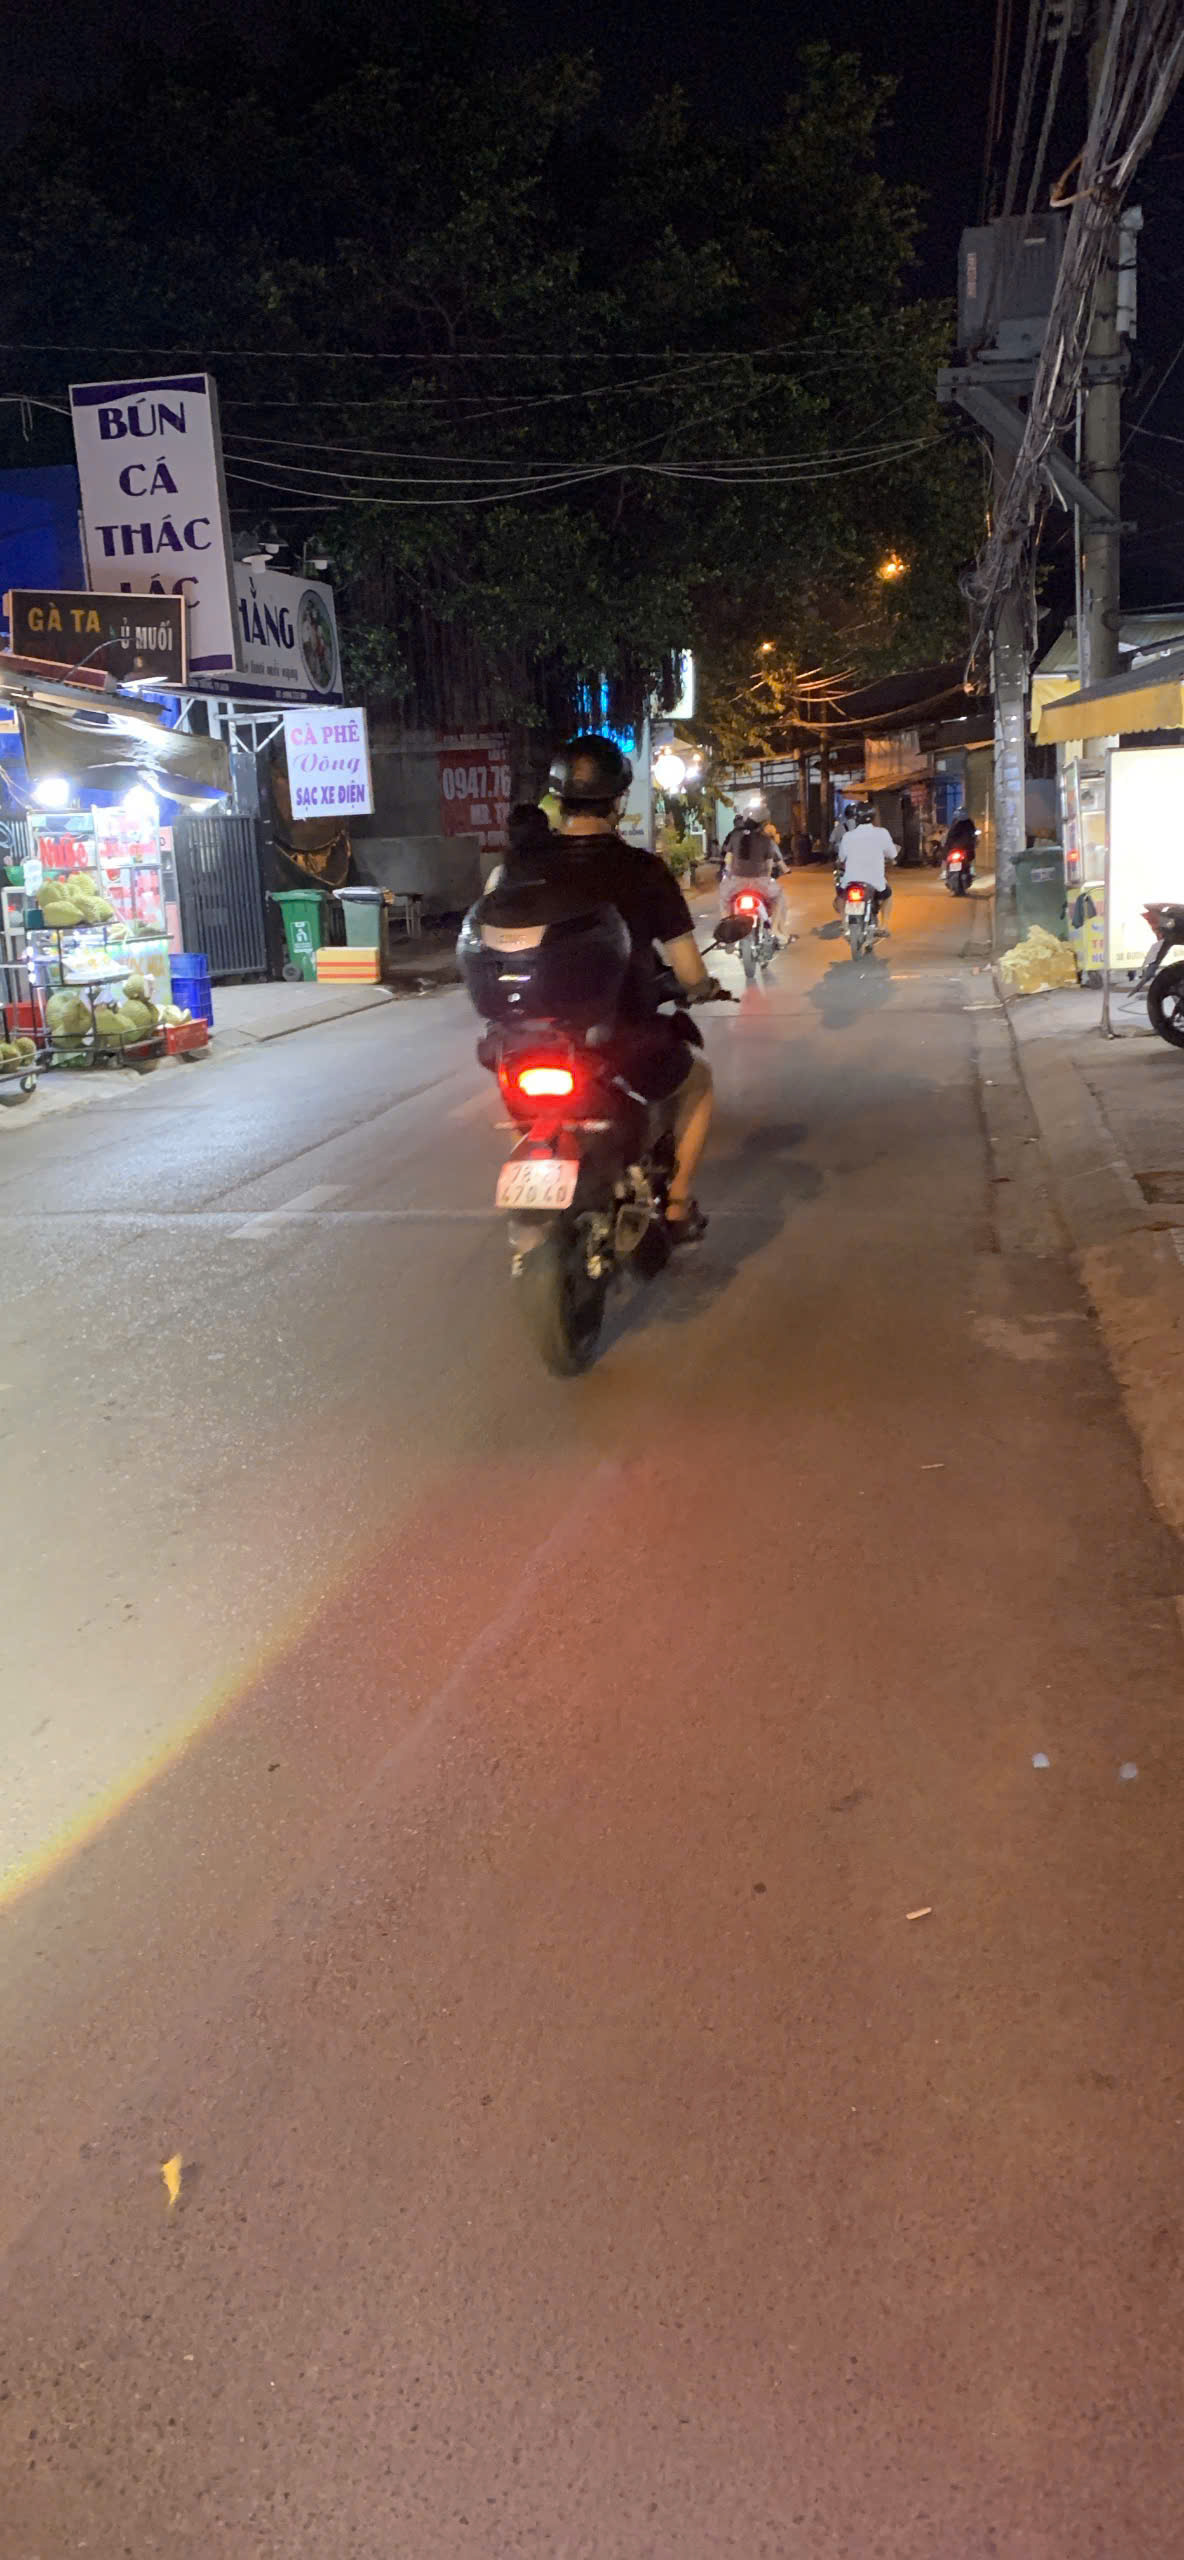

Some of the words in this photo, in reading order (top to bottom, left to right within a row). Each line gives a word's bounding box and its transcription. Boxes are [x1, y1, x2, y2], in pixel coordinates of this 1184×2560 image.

[98, 398, 187, 440] BÚN
[118, 456, 179, 497] CÁ
[95, 514, 213, 558] THÁC
[27, 601, 63, 633] GÀ
[69, 608, 102, 633] TA
[135, 619, 173, 652] MUỐI
[289, 722, 318, 745] CÀ
[321, 719, 360, 745] PHÊ
[296, 786, 318, 812] SẠC
[320, 785, 336, 805] XE
[338, 779, 366, 809] ĐIỆN
